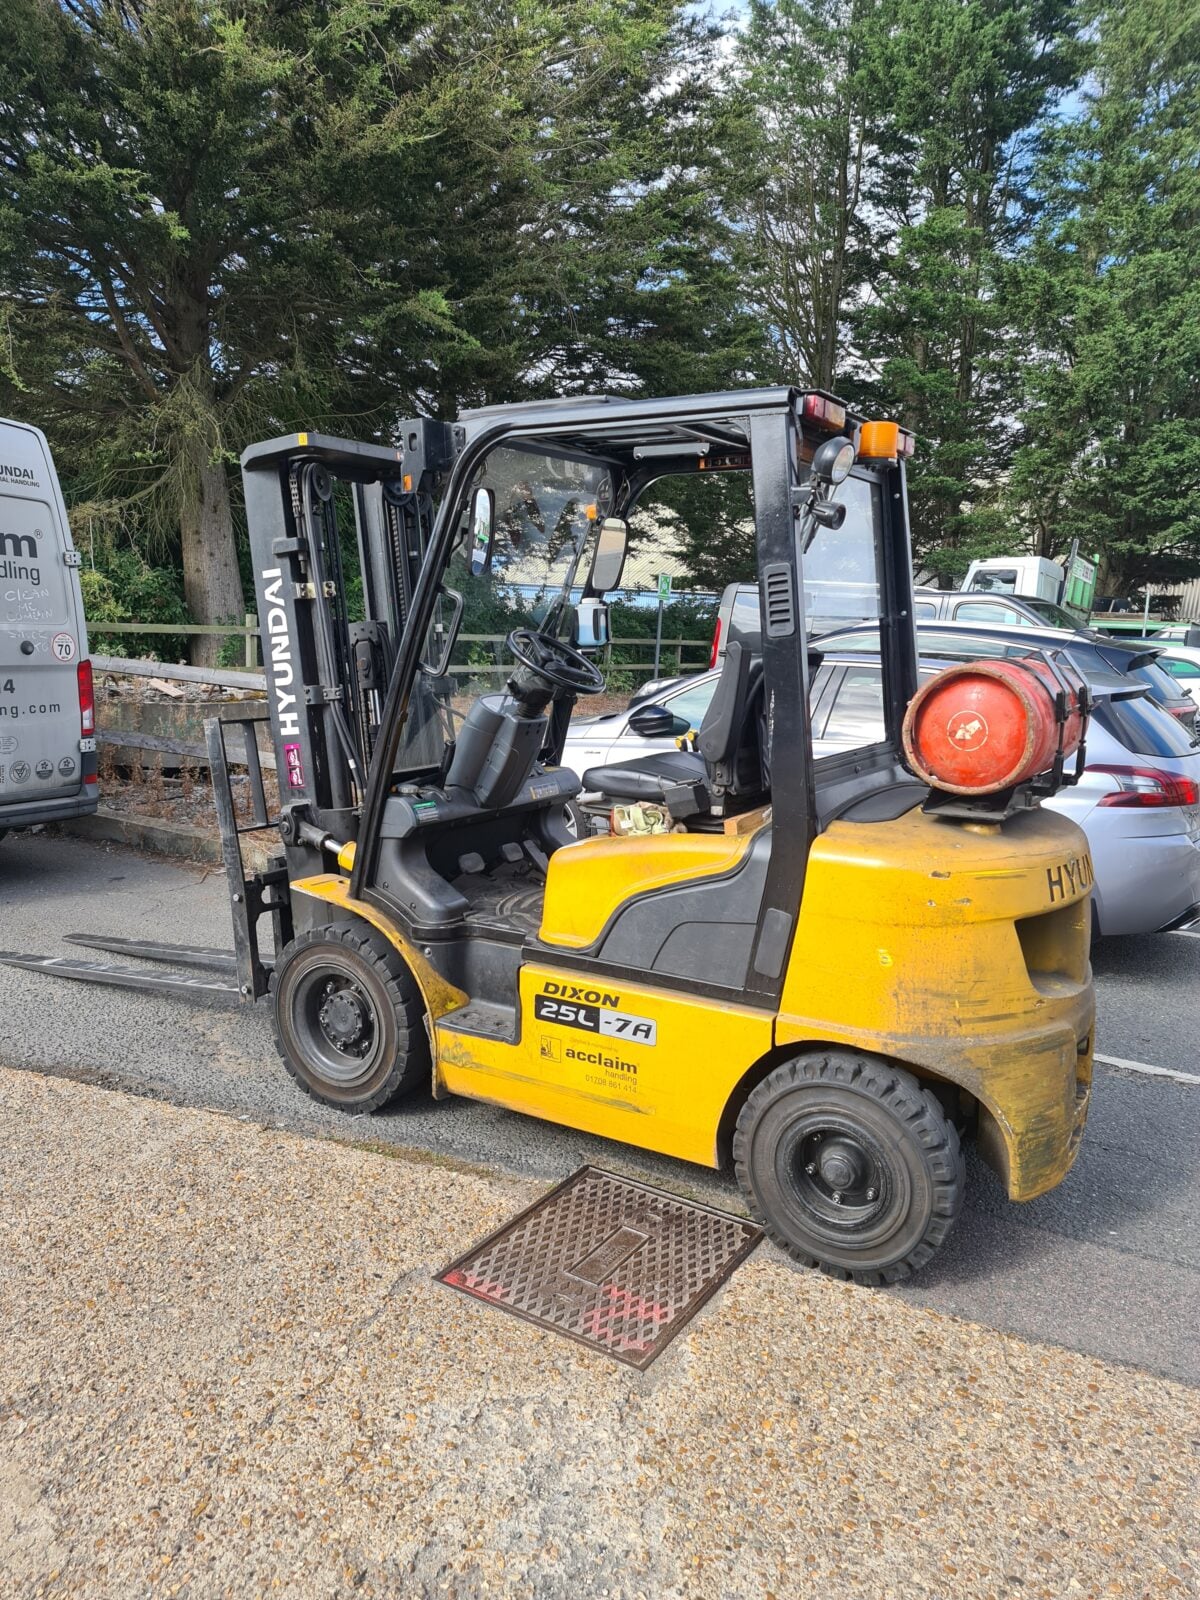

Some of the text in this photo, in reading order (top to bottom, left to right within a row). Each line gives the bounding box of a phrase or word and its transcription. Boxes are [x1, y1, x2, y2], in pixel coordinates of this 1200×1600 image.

[58, 644, 71, 656] 70
[262, 568, 300, 736] HYUNDAI
[543, 982, 620, 1008] DIXON
[565, 1048, 638, 1075] acclaim
[605, 1069, 638, 1086] handling
[624, 1085, 637, 1094] 414
